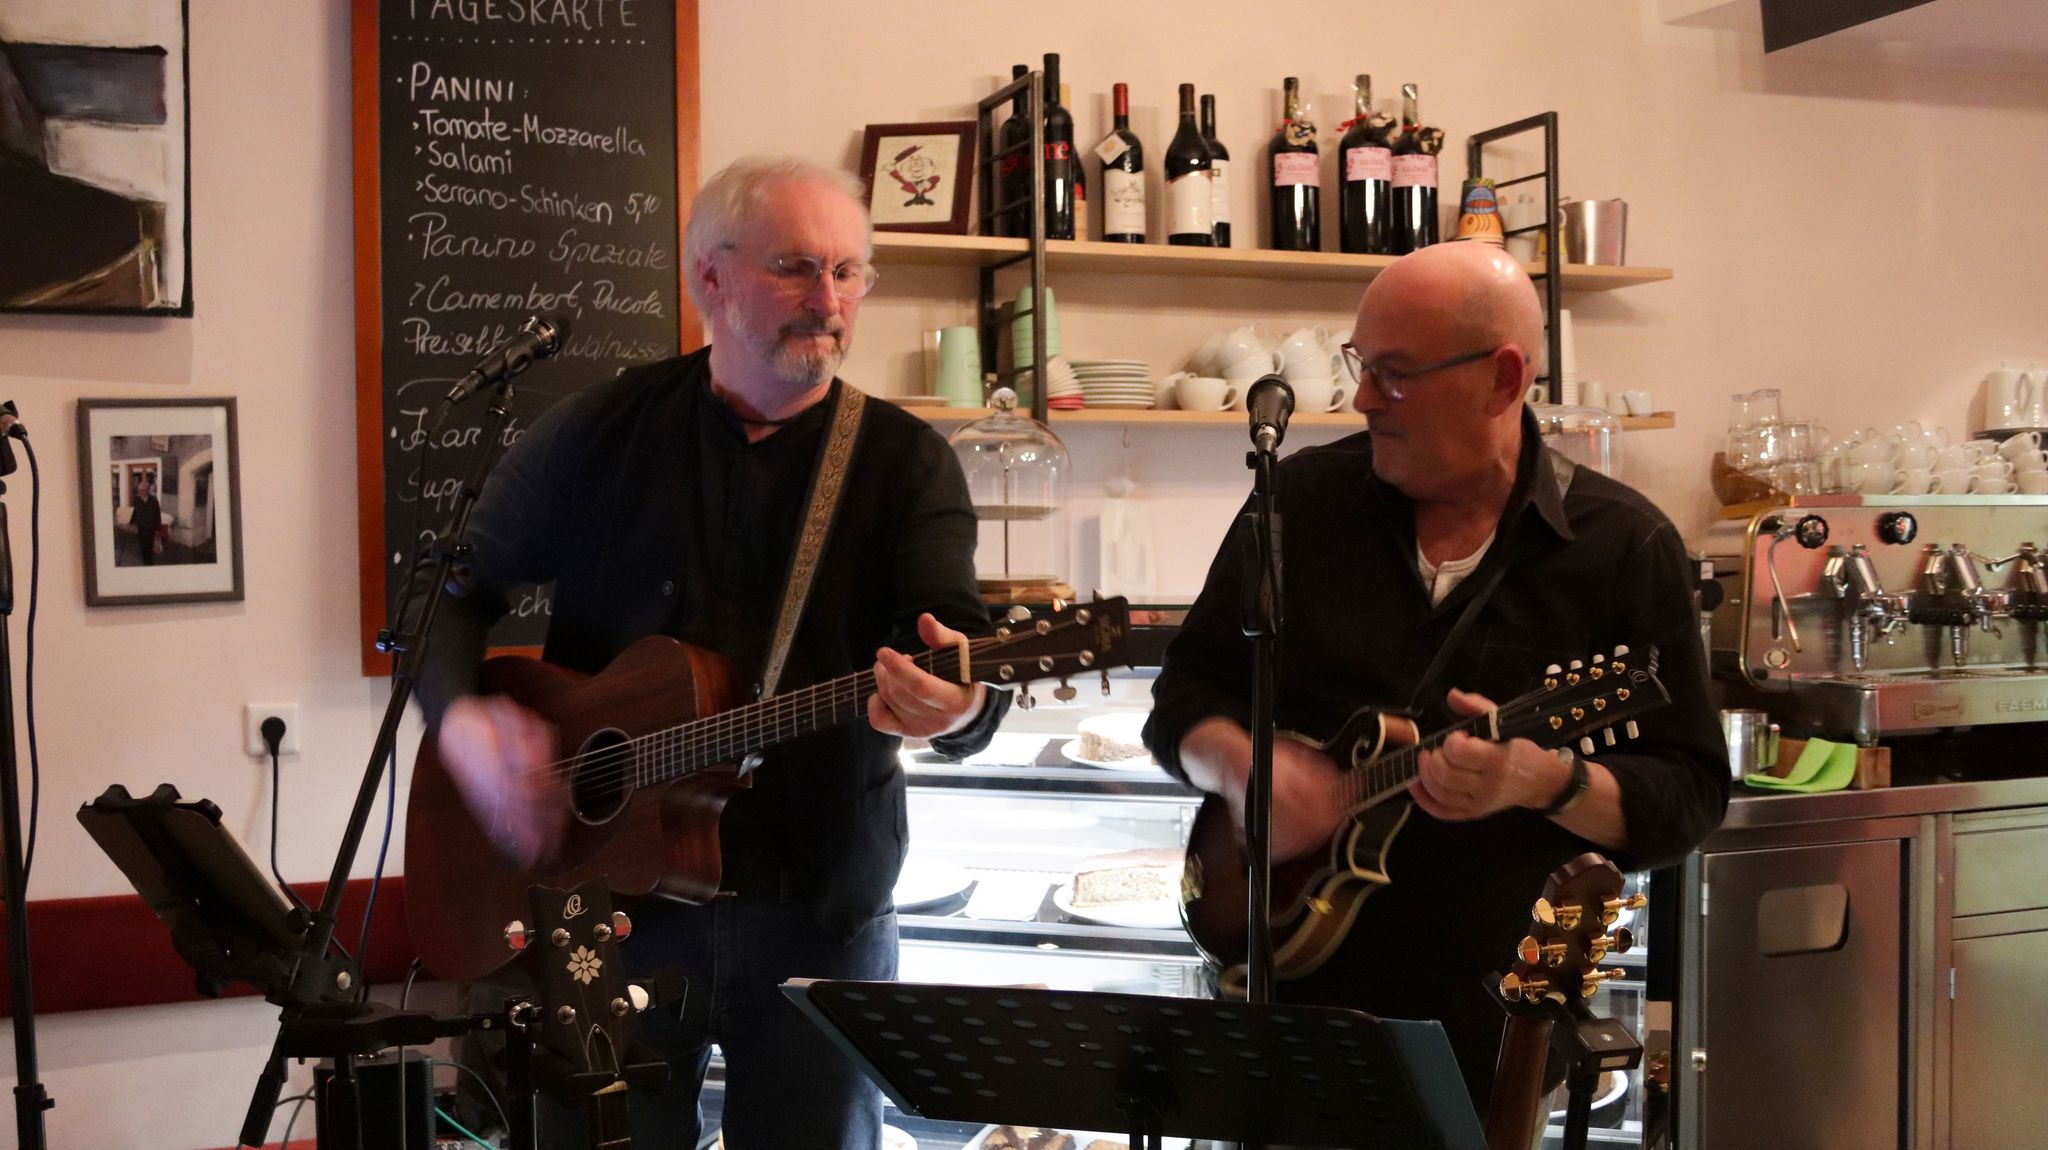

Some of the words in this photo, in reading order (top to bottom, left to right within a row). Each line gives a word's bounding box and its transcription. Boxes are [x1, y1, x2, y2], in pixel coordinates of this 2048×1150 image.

[419, 107, 646, 156] Tomate-Mozzarella
[428, 141, 513, 175] Salami
[424, 174, 613, 226] Serrano-Schinken
[407, 212, 536, 260] Panino
[1996, 696, 2048, 713] FAEM
